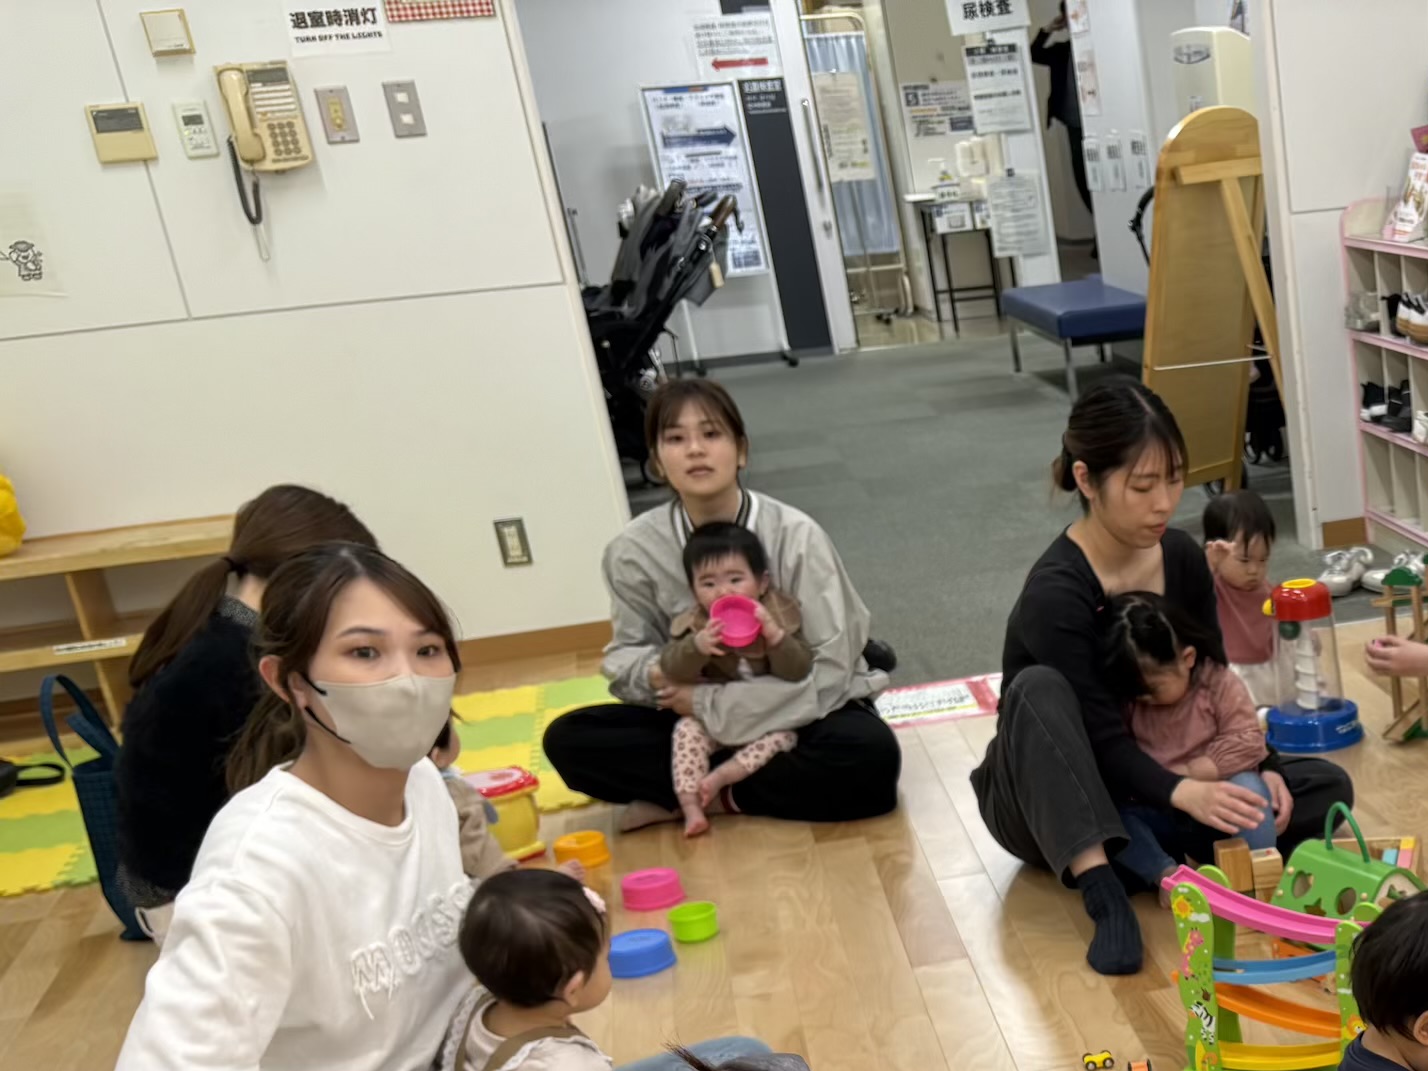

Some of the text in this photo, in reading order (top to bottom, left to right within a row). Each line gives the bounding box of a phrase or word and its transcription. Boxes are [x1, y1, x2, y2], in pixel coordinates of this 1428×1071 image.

[289, 7, 377, 29] 退室時消灯
[962, 0, 1013, 20] 尿検査
[294, 35, 317, 43] TURN
